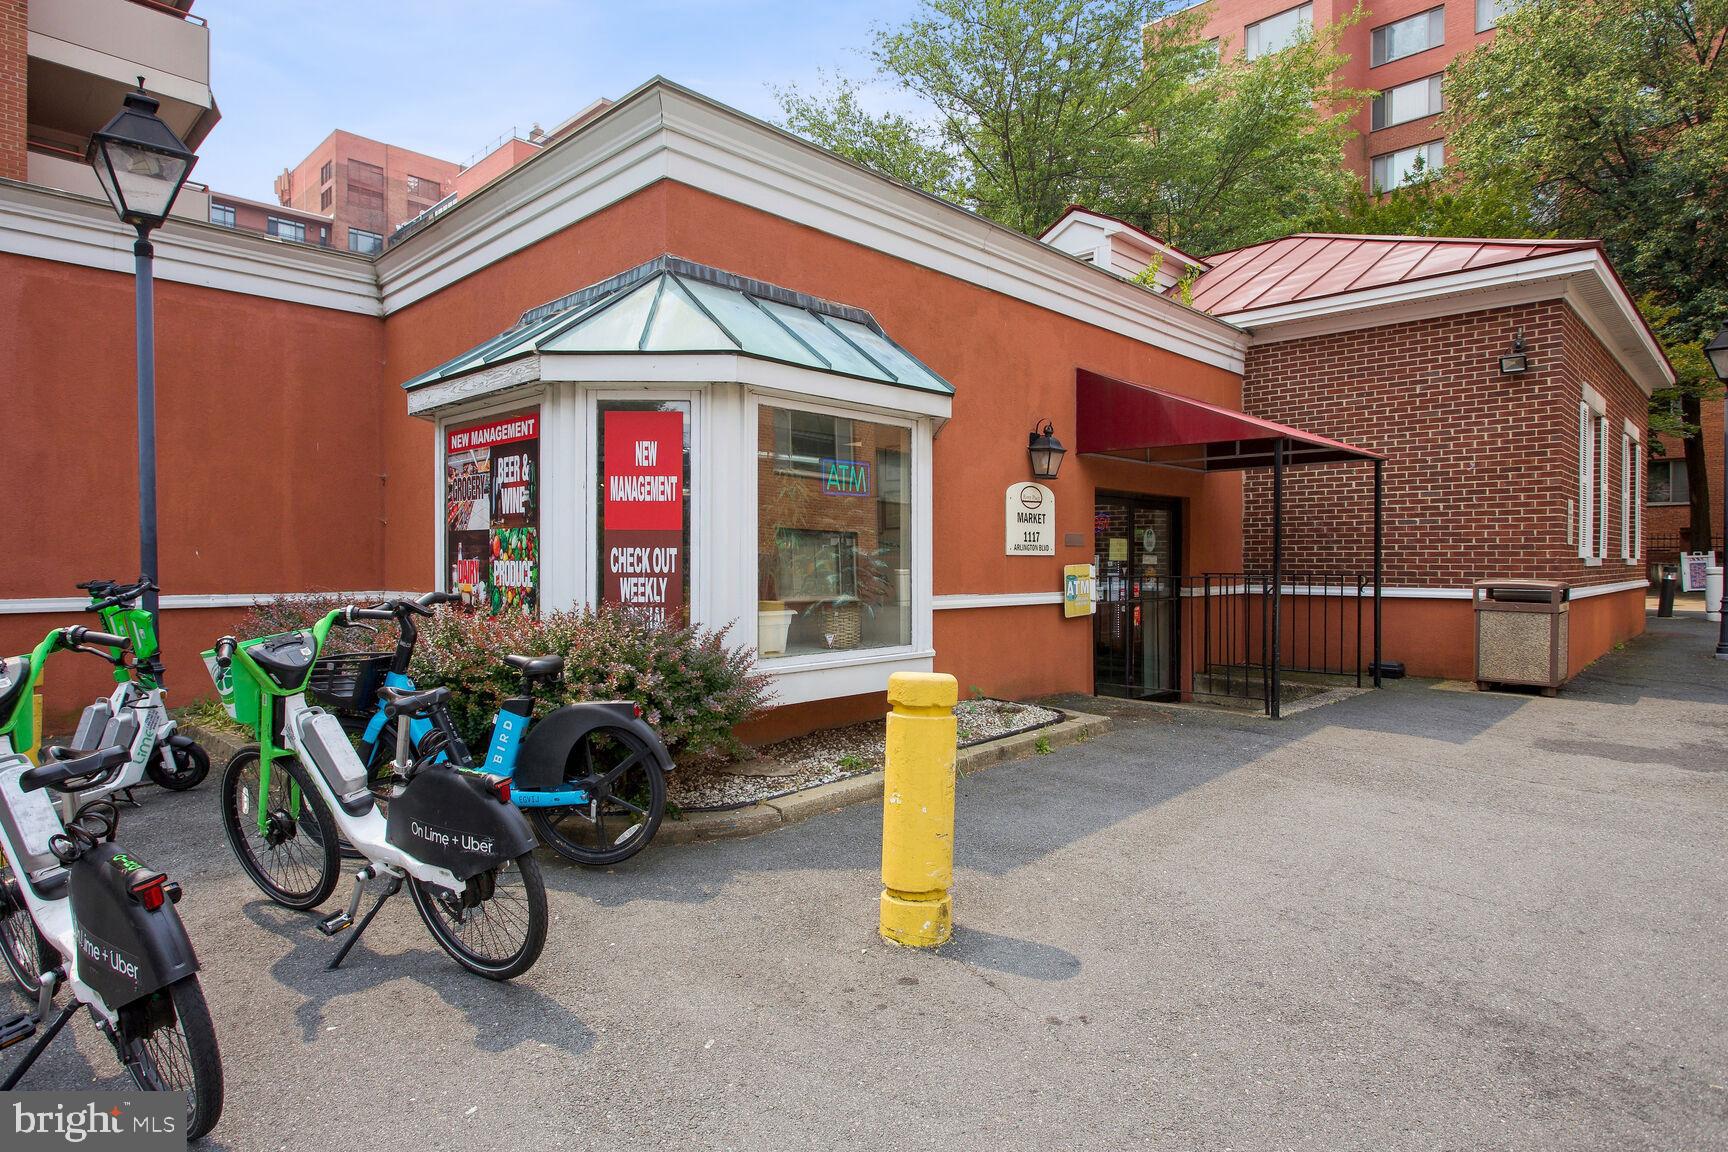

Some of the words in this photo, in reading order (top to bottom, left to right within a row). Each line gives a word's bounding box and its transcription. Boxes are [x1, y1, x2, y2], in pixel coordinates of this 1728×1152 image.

[451, 432, 469, 449] NEW
[471, 419, 535, 446] MANAGEMENT
[635, 440, 657, 467] NEW
[498, 455, 520, 483] BEER
[522, 453, 529, 481] &
[826, 463, 867, 492] ATM
[452, 474, 485, 502] GROCERY
[501, 486, 525, 515] WINE
[610, 475, 677, 502] MANAGEMENT
[1017, 512, 1046, 524] MARKET
[1013, 543, 1038, 552] ARLINGTON
[1038, 544, 1050, 552] BLVD
[1023, 531, 1040, 543] 1117
[458, 558, 480, 585] DAIRY
[493, 560, 533, 588] PRODUCE
[610, 547, 651, 574] CHECK
[652, 547, 678, 574] OUT
[620, 577, 668, 603] WEEKLY
[1067, 580, 1089, 596] ATM
[133, 729, 154, 764] Lime
[493, 719, 513, 764] BIRD
[411, 821, 424, 838] On
[425, 825, 449, 846] Lime
[452, 836, 459, 845] +
[461, 835, 494, 854] Uber
[110, 950, 139, 980] Uber
